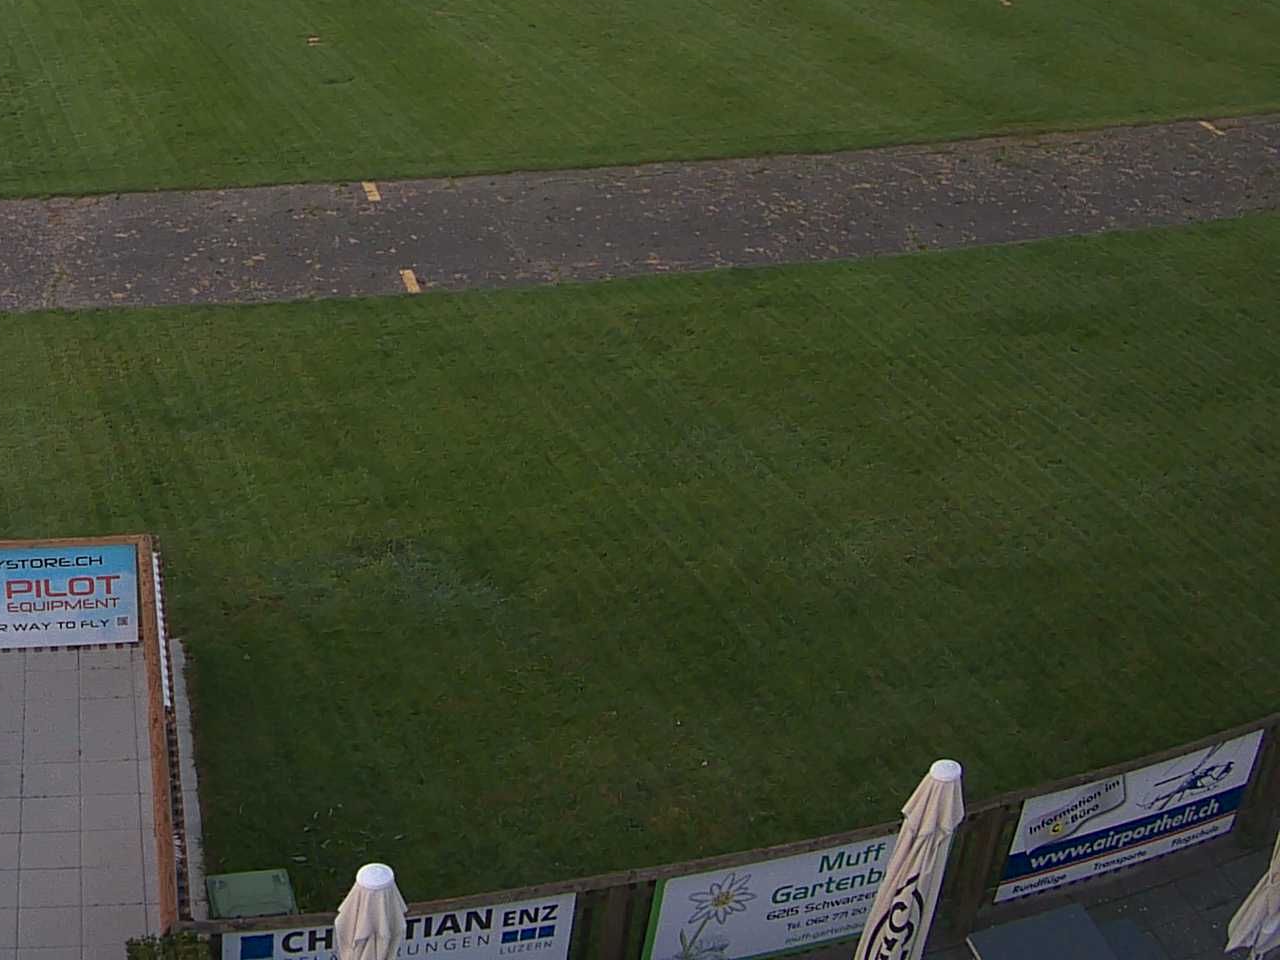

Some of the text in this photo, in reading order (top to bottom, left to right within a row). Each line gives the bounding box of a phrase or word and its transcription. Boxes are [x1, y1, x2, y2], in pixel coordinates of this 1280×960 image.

[5, 575, 120, 599] PILOT
[7, 597, 120, 613] EQUIPMENT
[12, 622, 50, 632] WAY
[58, 621, 76, 630] TO
[80, 619, 110, 629] FLY
[1029, 779, 1120, 835] Information im
[1031, 799, 1220, 869] www.airportheli.ch
[818, 842, 886, 873] Muff
[502, 904, 559, 928] ENZ
[766, 906, 800, 921] 6215
[499, 940, 553, 955] LUZERN
